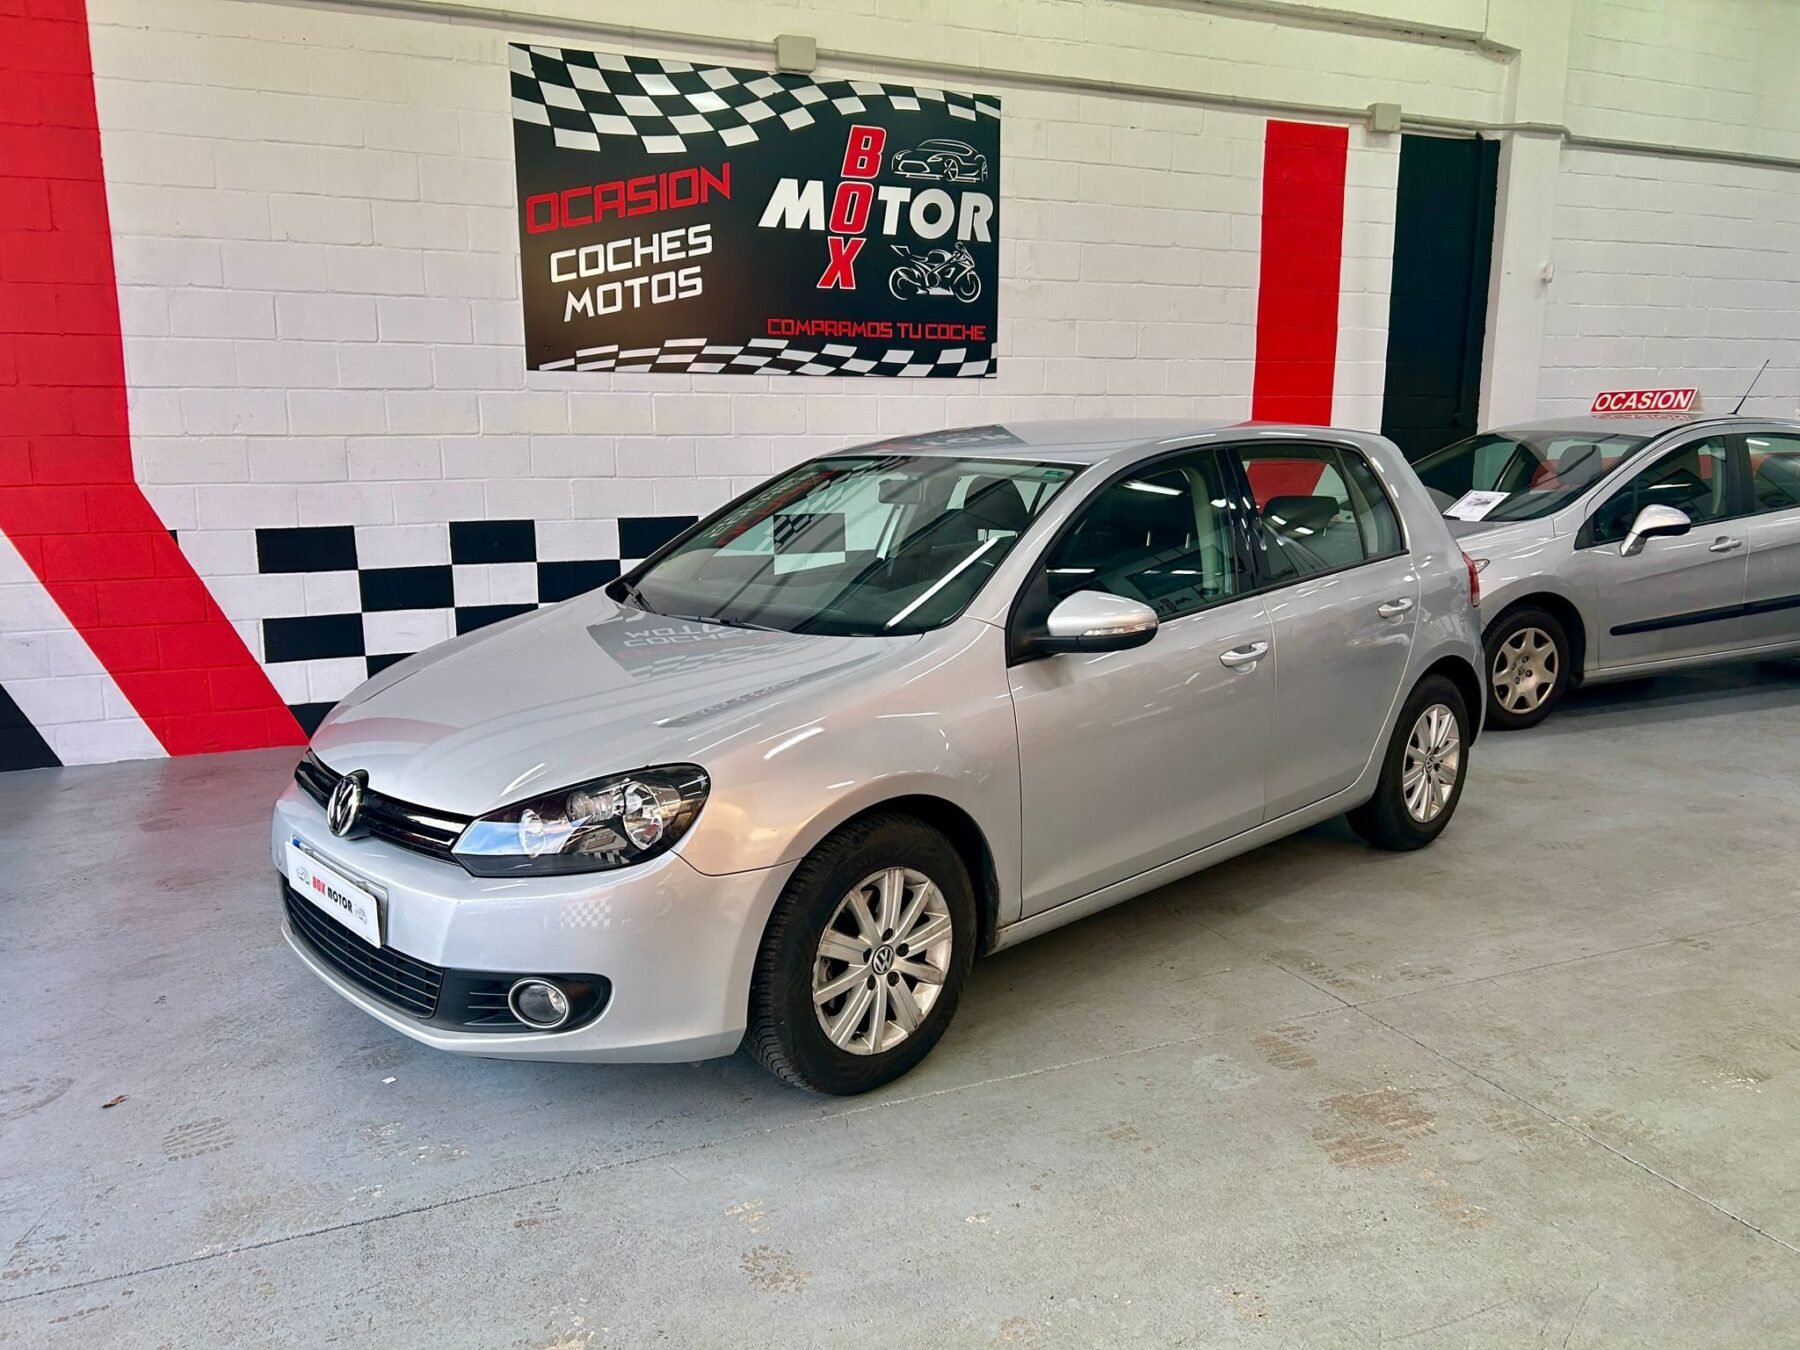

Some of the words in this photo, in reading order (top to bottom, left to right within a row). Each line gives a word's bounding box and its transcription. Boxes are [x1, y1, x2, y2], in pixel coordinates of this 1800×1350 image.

[525, 162, 731, 234] OCASION
[757, 177, 994, 243] MOTOR
[816, 124, 887, 290] BOX
[550, 223, 713, 283] COCHES
[563, 265, 703, 322] MOTOS
[767, 318, 893, 338] COMPRAMOS
[897, 323, 922, 339] TU
[925, 324, 986, 341] COCHE
[1594, 390, 1693, 411] OCASION
[312, 875, 326, 896] BOX
[327, 886, 353, 914] MOTOR
